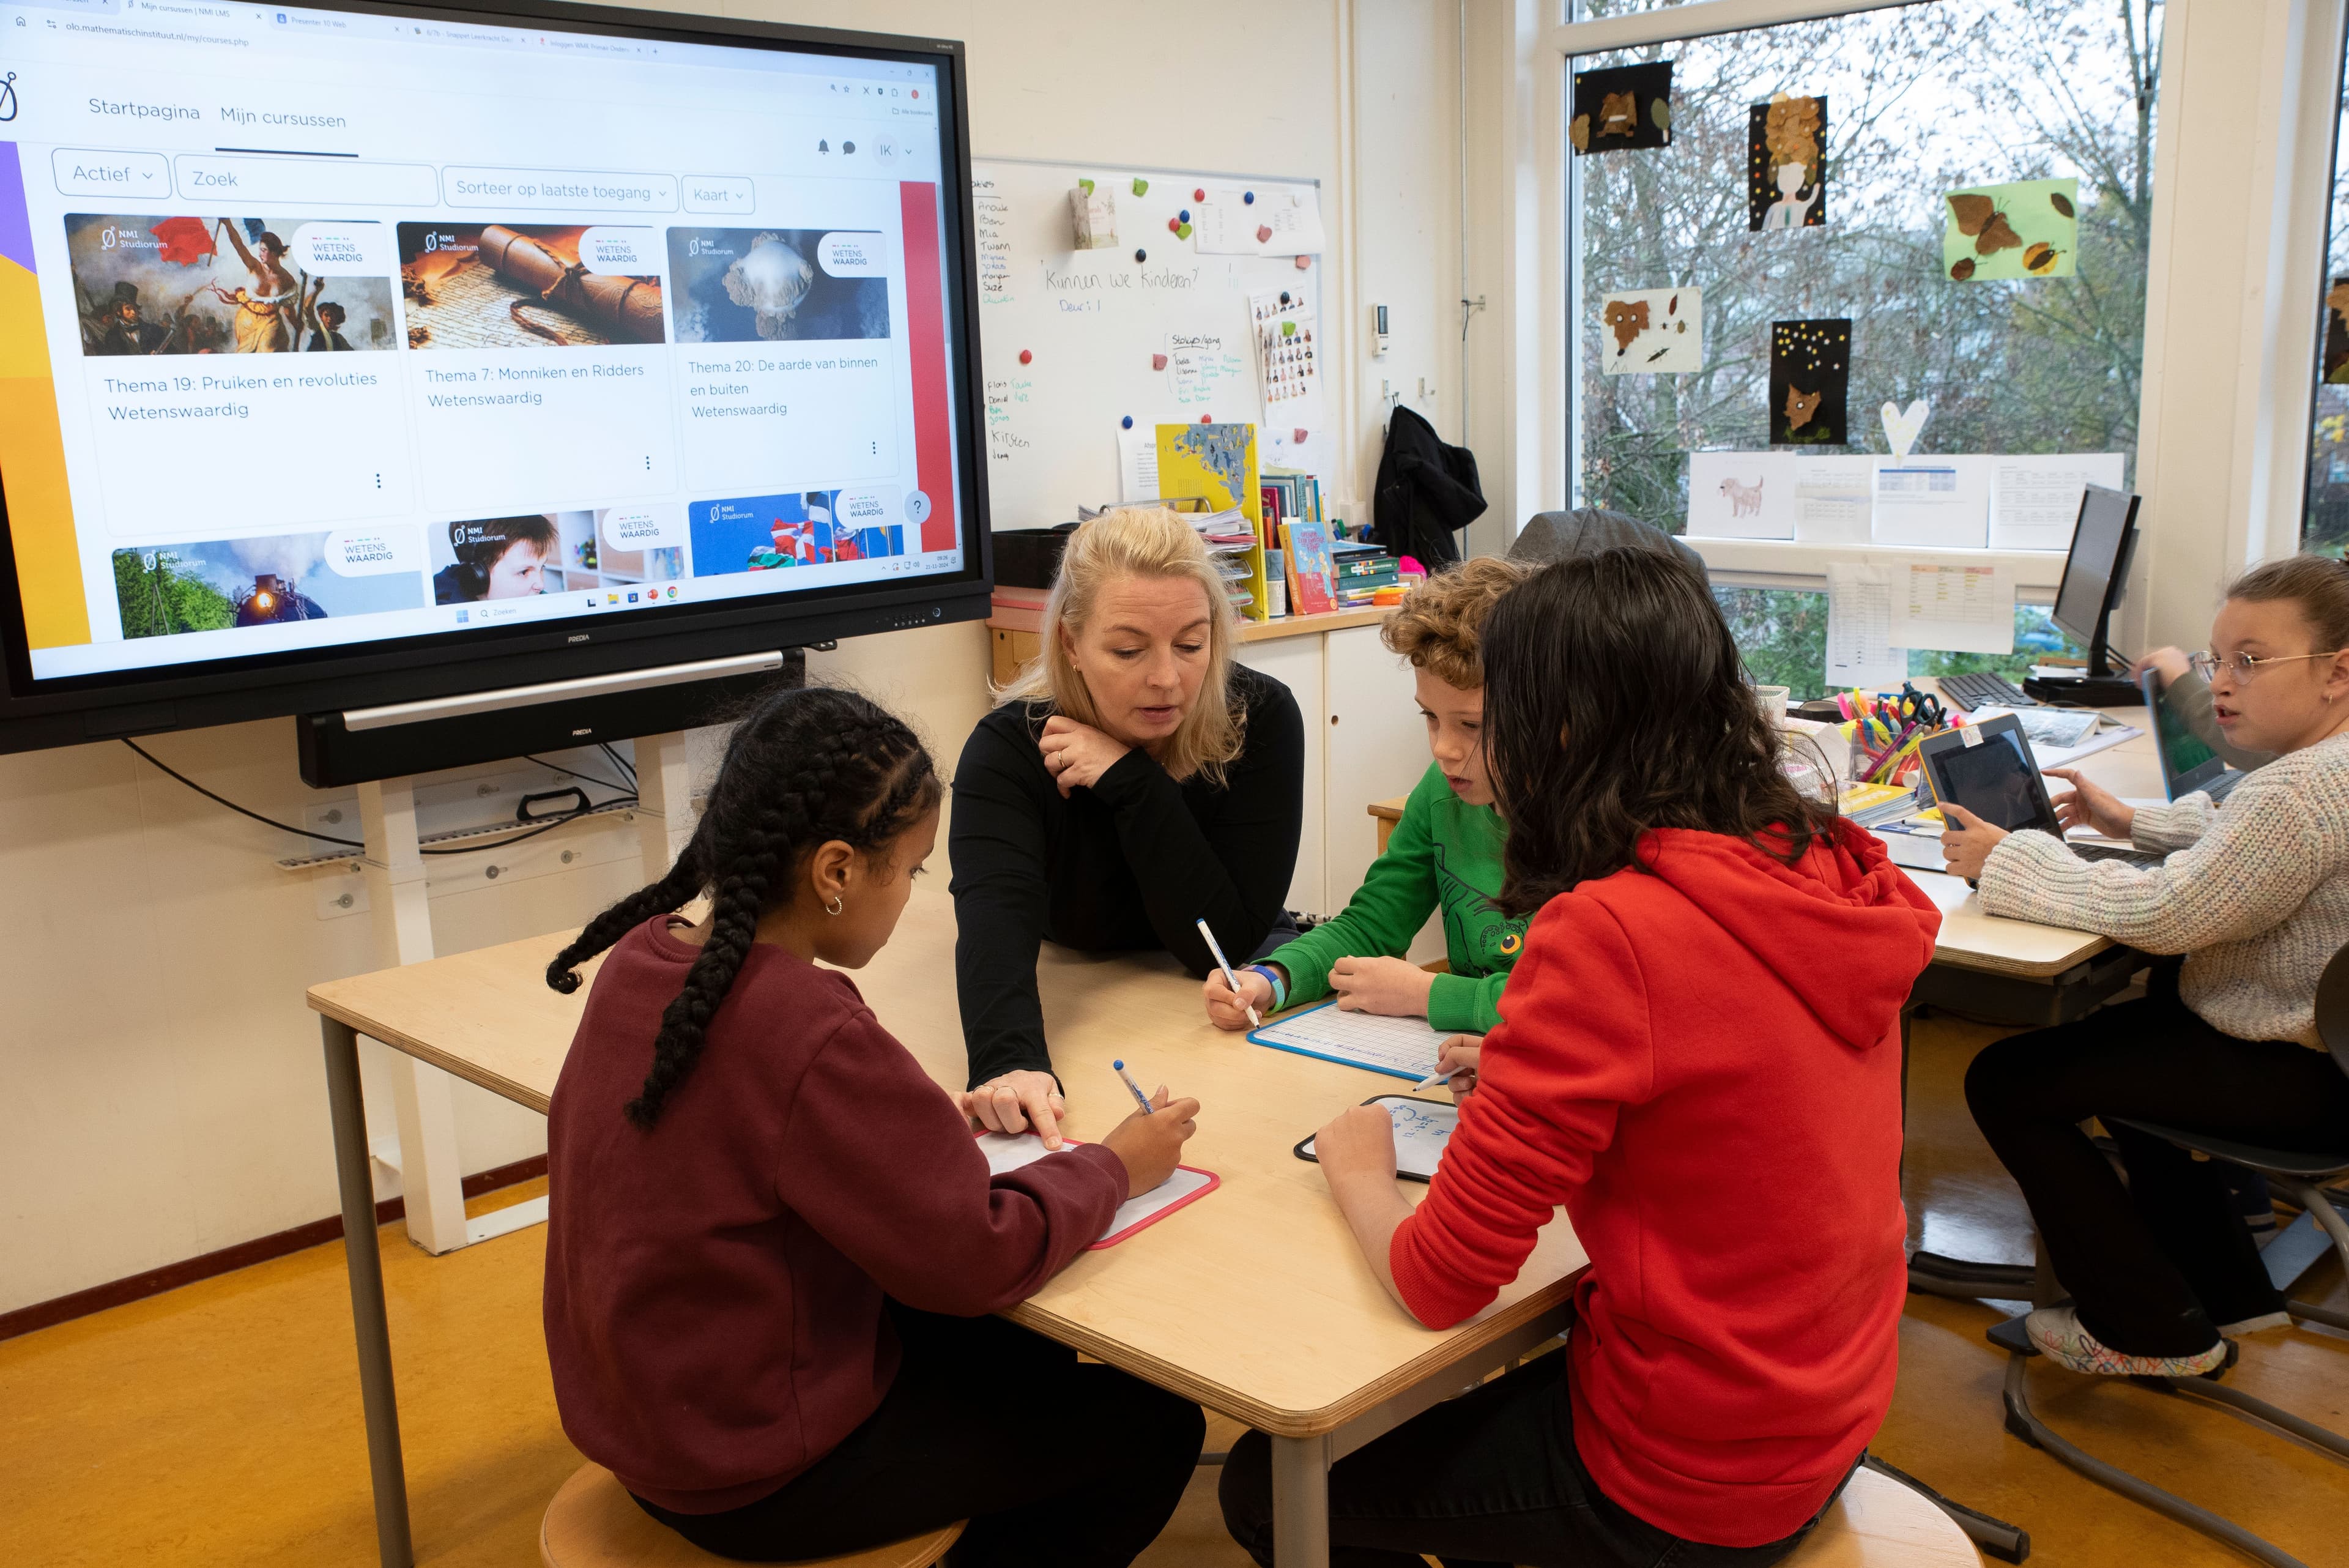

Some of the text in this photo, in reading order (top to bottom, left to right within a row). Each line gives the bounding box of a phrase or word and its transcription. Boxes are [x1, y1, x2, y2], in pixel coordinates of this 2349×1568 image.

[141, 2, 231, 18] Mijn cursussen NMI LMS
[291, 17, 321, 26] Presenter
[89, 98, 347, 128] Startpagina Mijn cursussen
[880, 144, 891, 157] IK
[73, 165, 131, 182] Actief
[193, 171, 239, 187] Zoek
[456, 180, 651, 201] Sorteer op laatste toegang
[694, 188, 729, 202] Kaart
[119, 230, 138, 239] NMI
[439, 234, 455, 243] NMI
[119, 240, 168, 250] Studiorum
[312, 243, 356, 253] WETENS
[440, 243, 479, 251] Studiorum
[314, 253, 363, 262] WAARDIG
[1045, 269, 1103, 291] Kunnen
[688, 357, 878, 374] Thema 20: De aarde van binnen
[426, 364, 644, 382] Thema 7: Monniken en Ridders
[104, 372, 377, 393] Thema 19: Pruiken en revoluties
[691, 383, 749, 396] en buiten
[428, 391, 542, 407] Wetenswaardig
[108, 402, 249, 421] Wetenswaardig
[691, 403, 787, 418] Wetenswaardig
[850, 500, 880, 510] WETENS
[722, 511, 754, 520] Studiorum
[850, 508, 884, 518] WAARDIG
[468, 526, 483, 535] NMI
[619, 520, 655, 530] WETENS
[468, 533, 506, 544] Studiorum
[620, 528, 659, 539] WAARDIG
[344, 543, 386, 554] WETENS
[159, 551, 178, 561] NMI
[346, 552, 393, 563] WAARDIG
[160, 558, 207, 570] Studiorum
[493, 607, 517, 617] Zoeken
